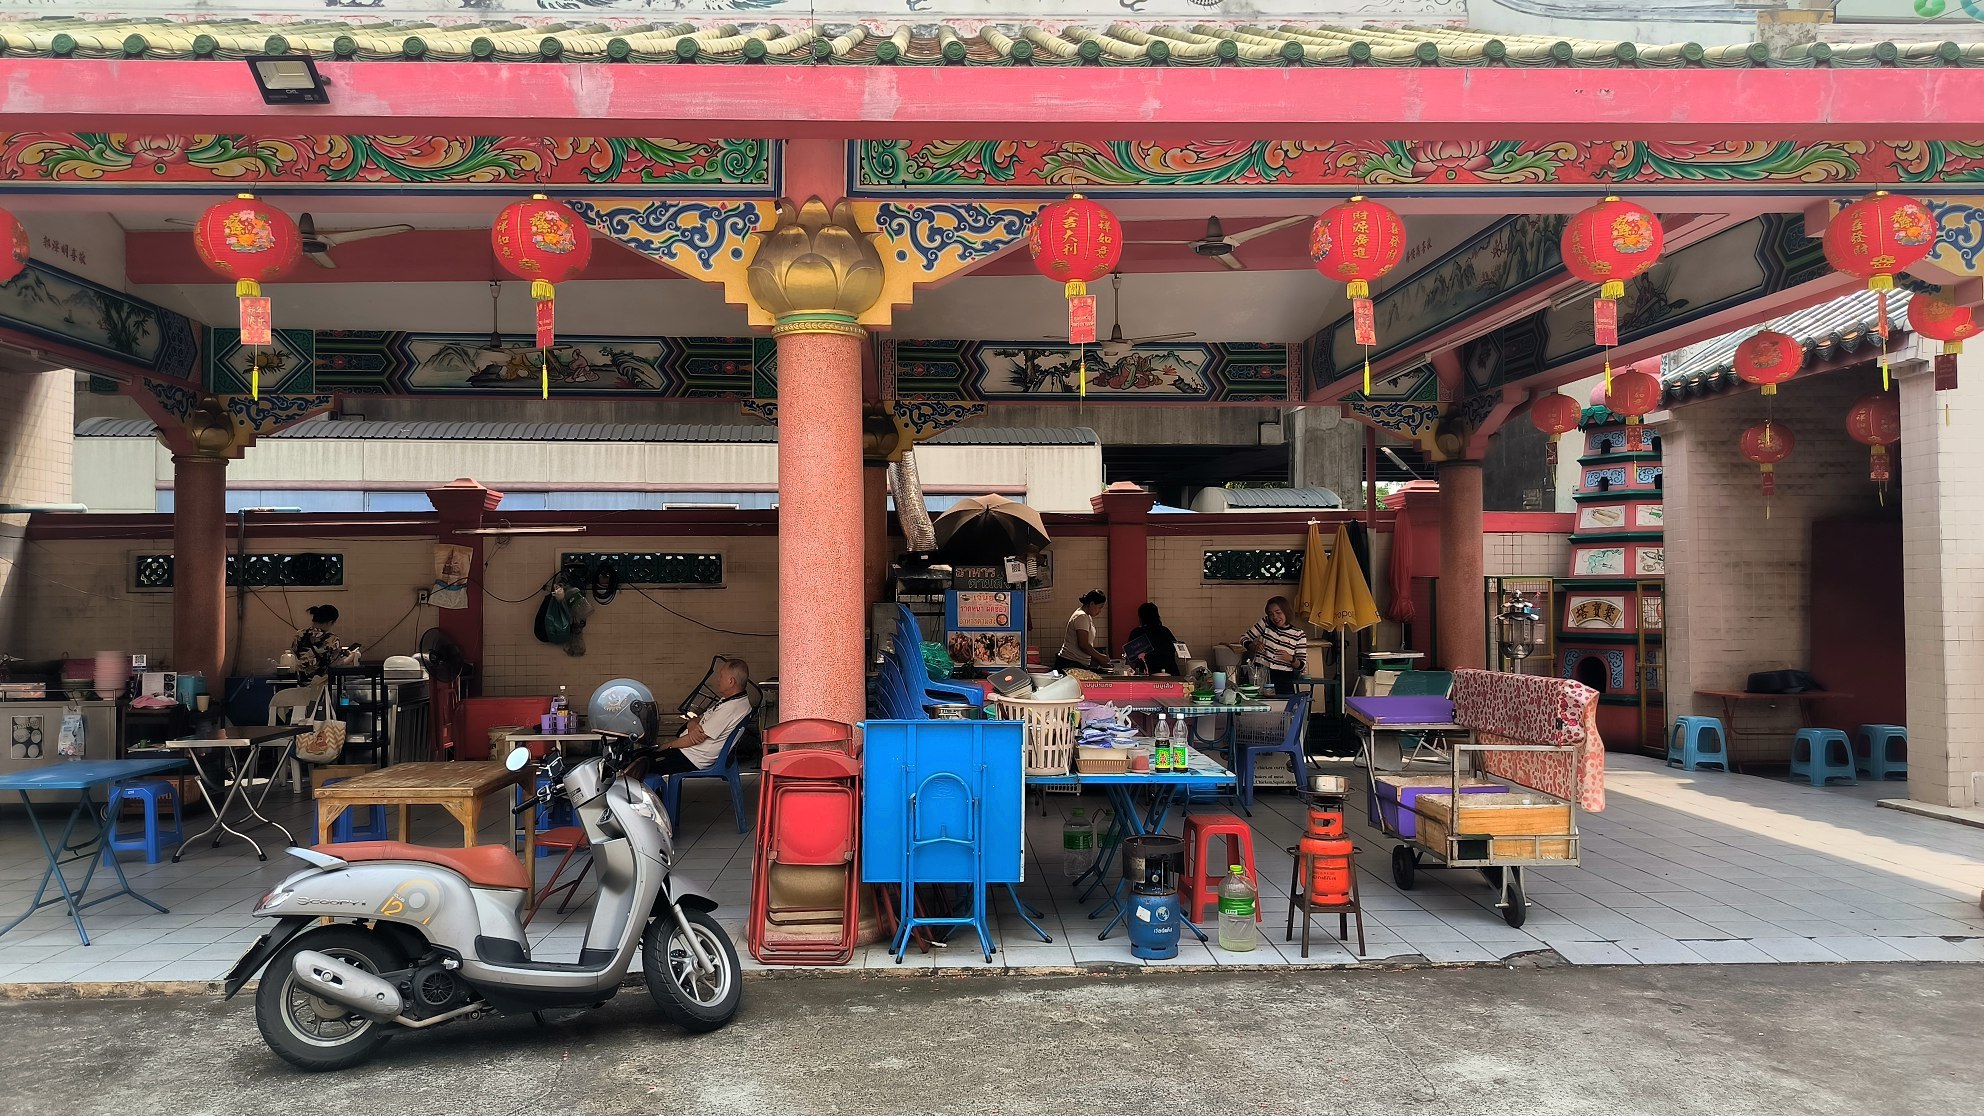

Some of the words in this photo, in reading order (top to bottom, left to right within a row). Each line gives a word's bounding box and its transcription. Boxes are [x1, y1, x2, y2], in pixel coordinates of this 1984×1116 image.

[1062, 206, 1079, 256] 大吉大利
[1094, 209, 1113, 259] 吉祥如意
[1352, 210, 1370, 259] 財源廣進
[955, 567, 996, 578] อาหาร
[381, 896, 403, 916] 12
